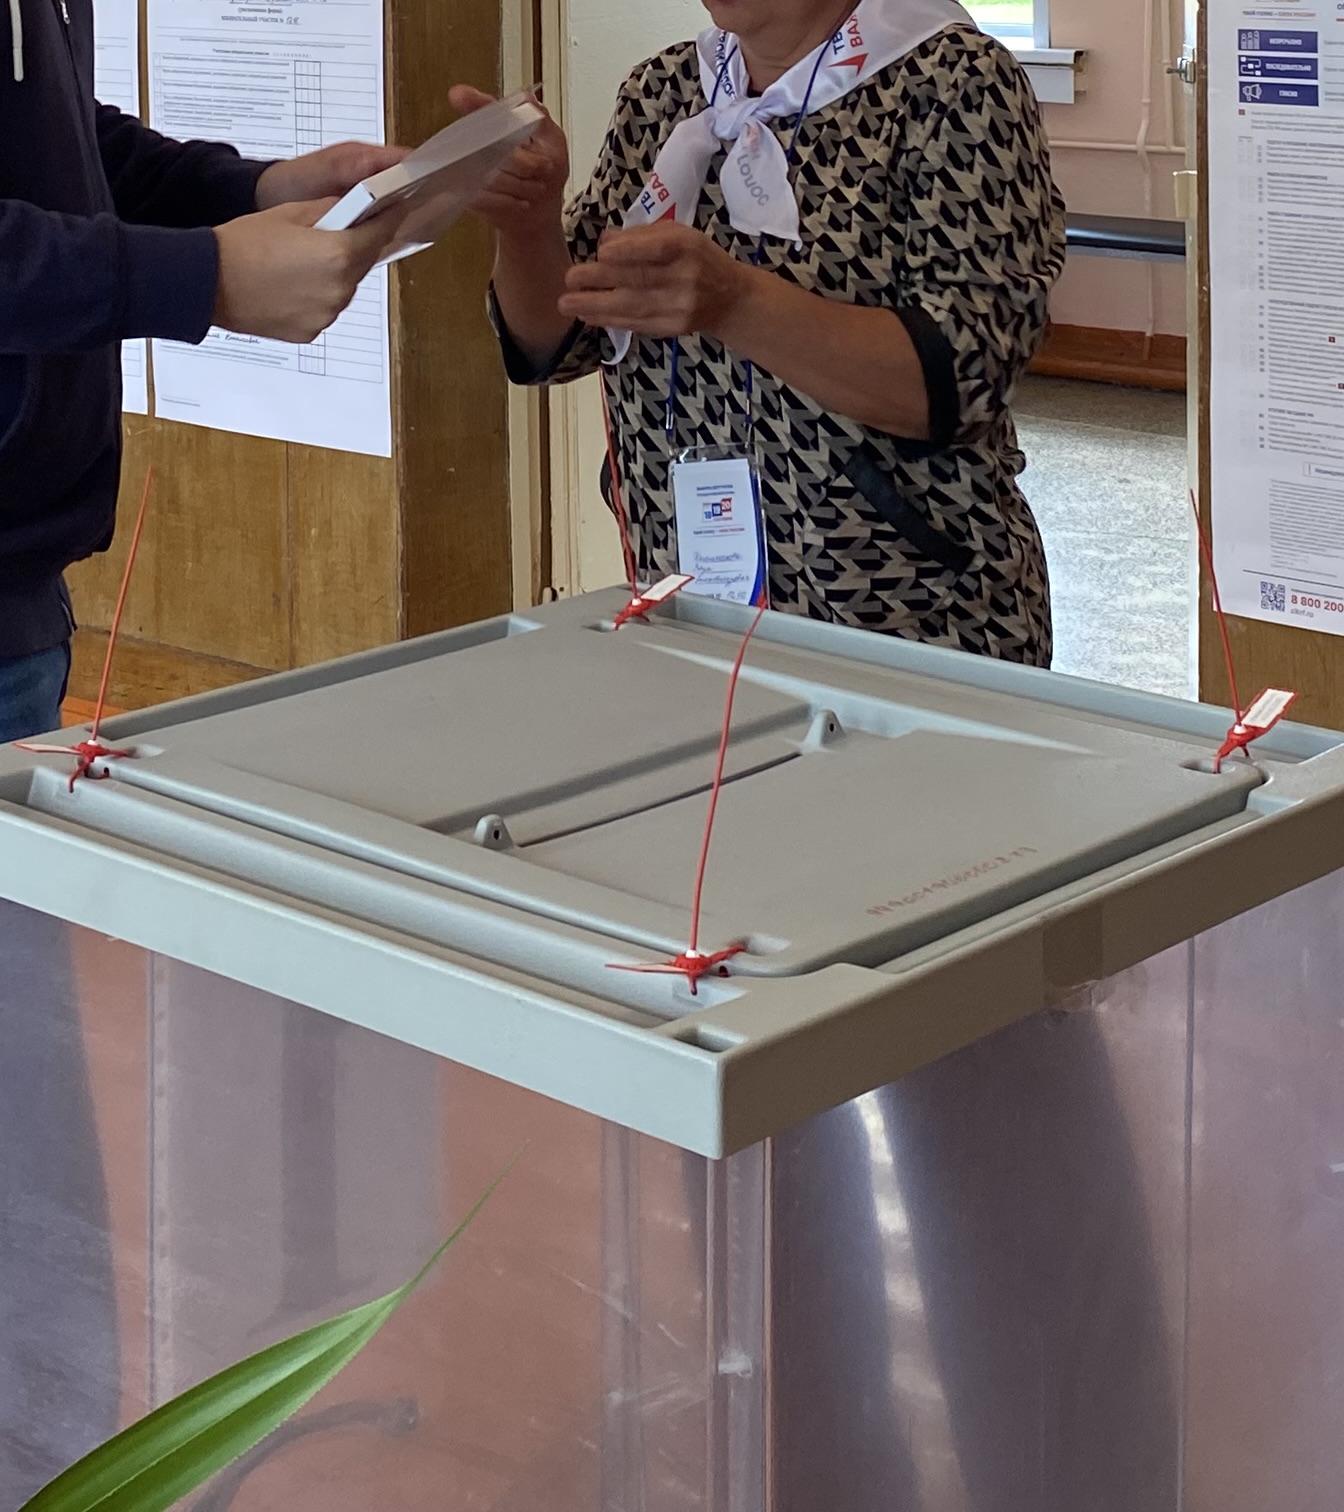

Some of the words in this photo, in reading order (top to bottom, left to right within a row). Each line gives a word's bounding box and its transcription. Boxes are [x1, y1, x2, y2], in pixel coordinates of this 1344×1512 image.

[1291, 595, 1298, 604] 8
[1300, 596, 1321, 609] 800
[1324, 600, 1344, 613] 200
